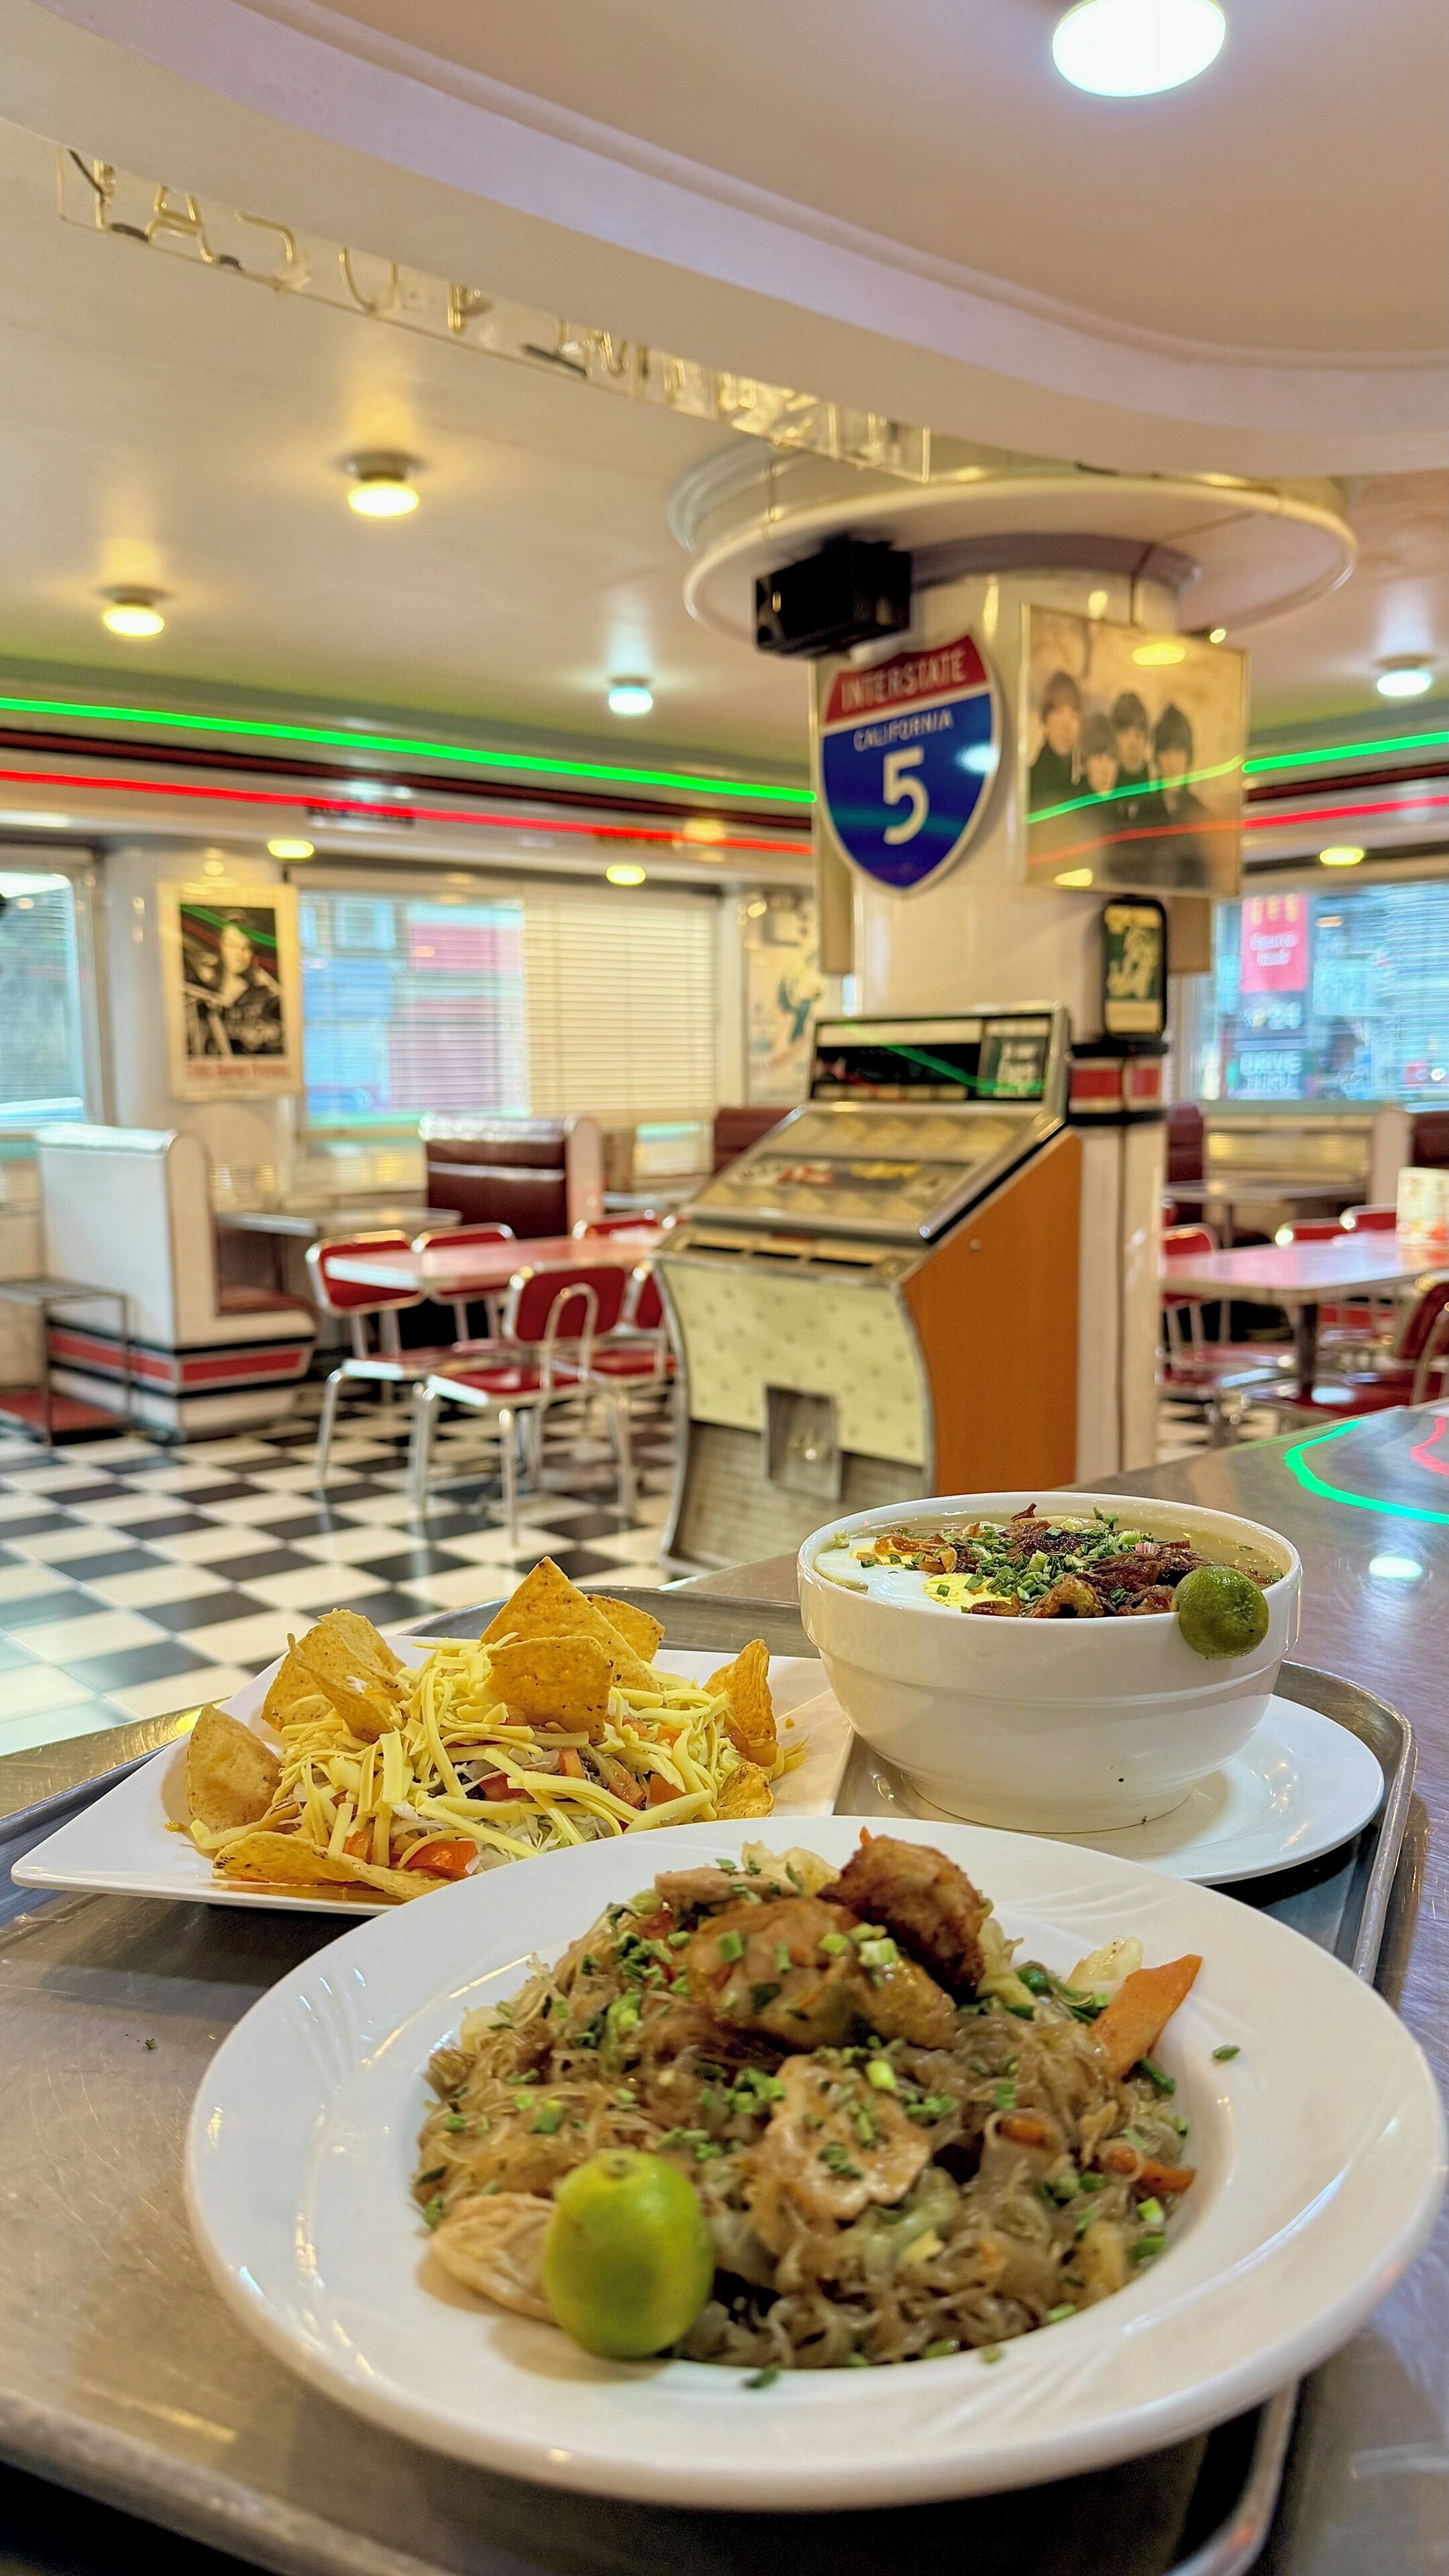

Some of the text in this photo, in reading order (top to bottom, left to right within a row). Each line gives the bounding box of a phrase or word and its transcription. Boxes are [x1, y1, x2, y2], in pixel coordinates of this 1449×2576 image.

[841, 648, 967, 712] INTERSTATE
[853, 707, 954, 752] CALIFORNIA
[882, 745, 930, 845] 5
[1240, 1051, 1303, 1075] DRIVE
